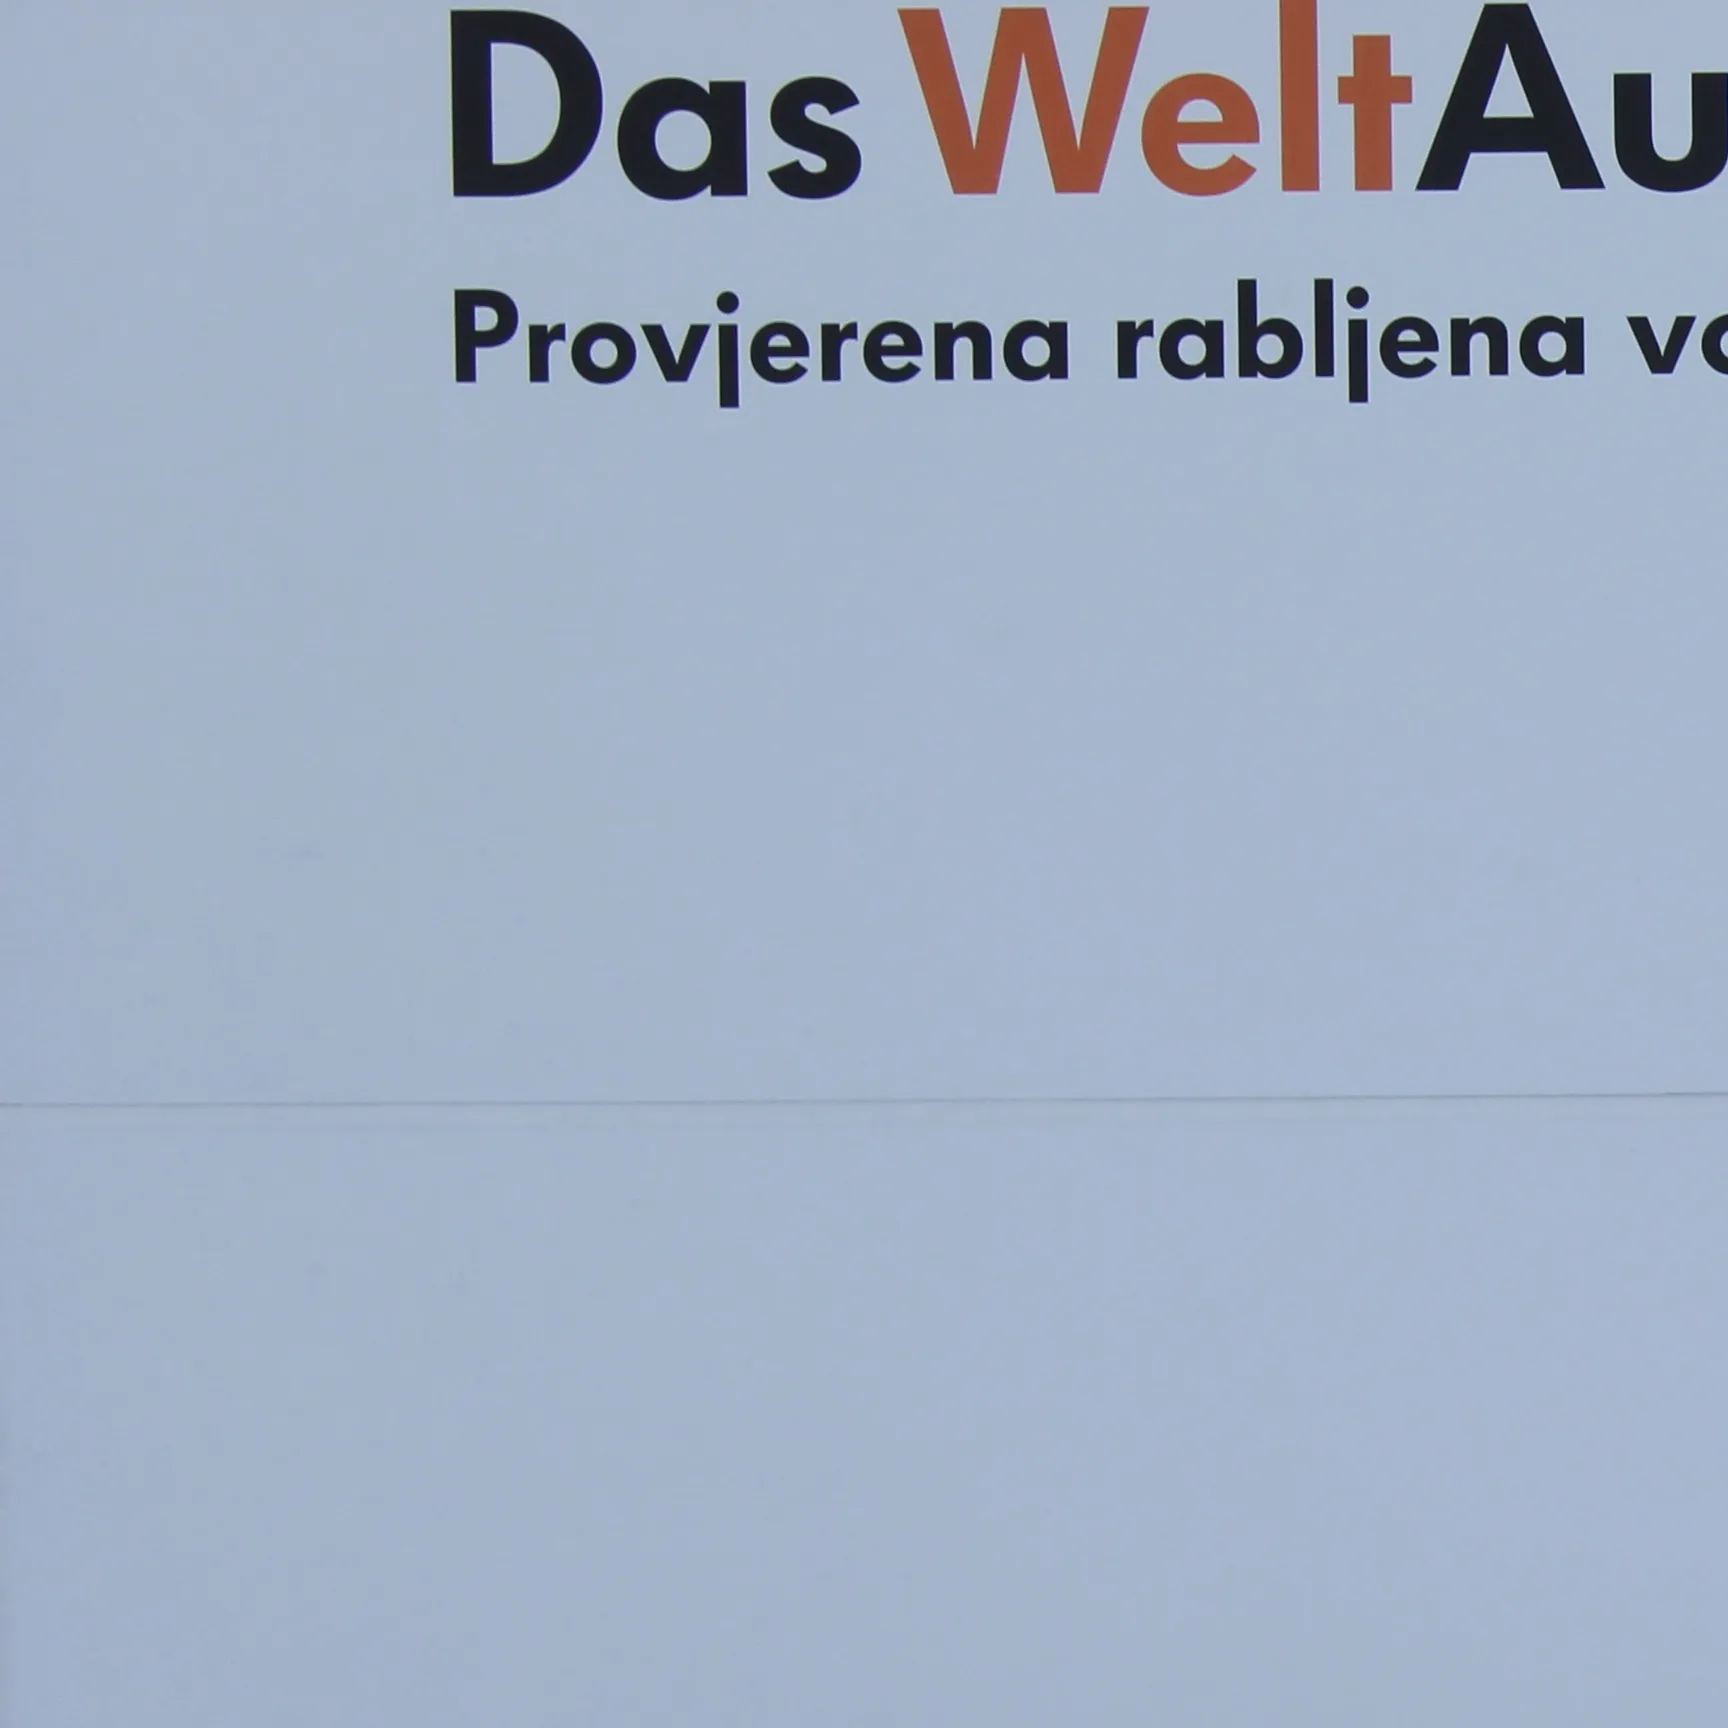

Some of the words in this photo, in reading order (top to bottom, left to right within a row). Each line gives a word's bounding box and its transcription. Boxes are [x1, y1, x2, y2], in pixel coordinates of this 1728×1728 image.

[450, 8, 863, 199] Das
[453, 288, 1069, 408] Provjerena
[1116, 277, 1586, 403] rabljena
